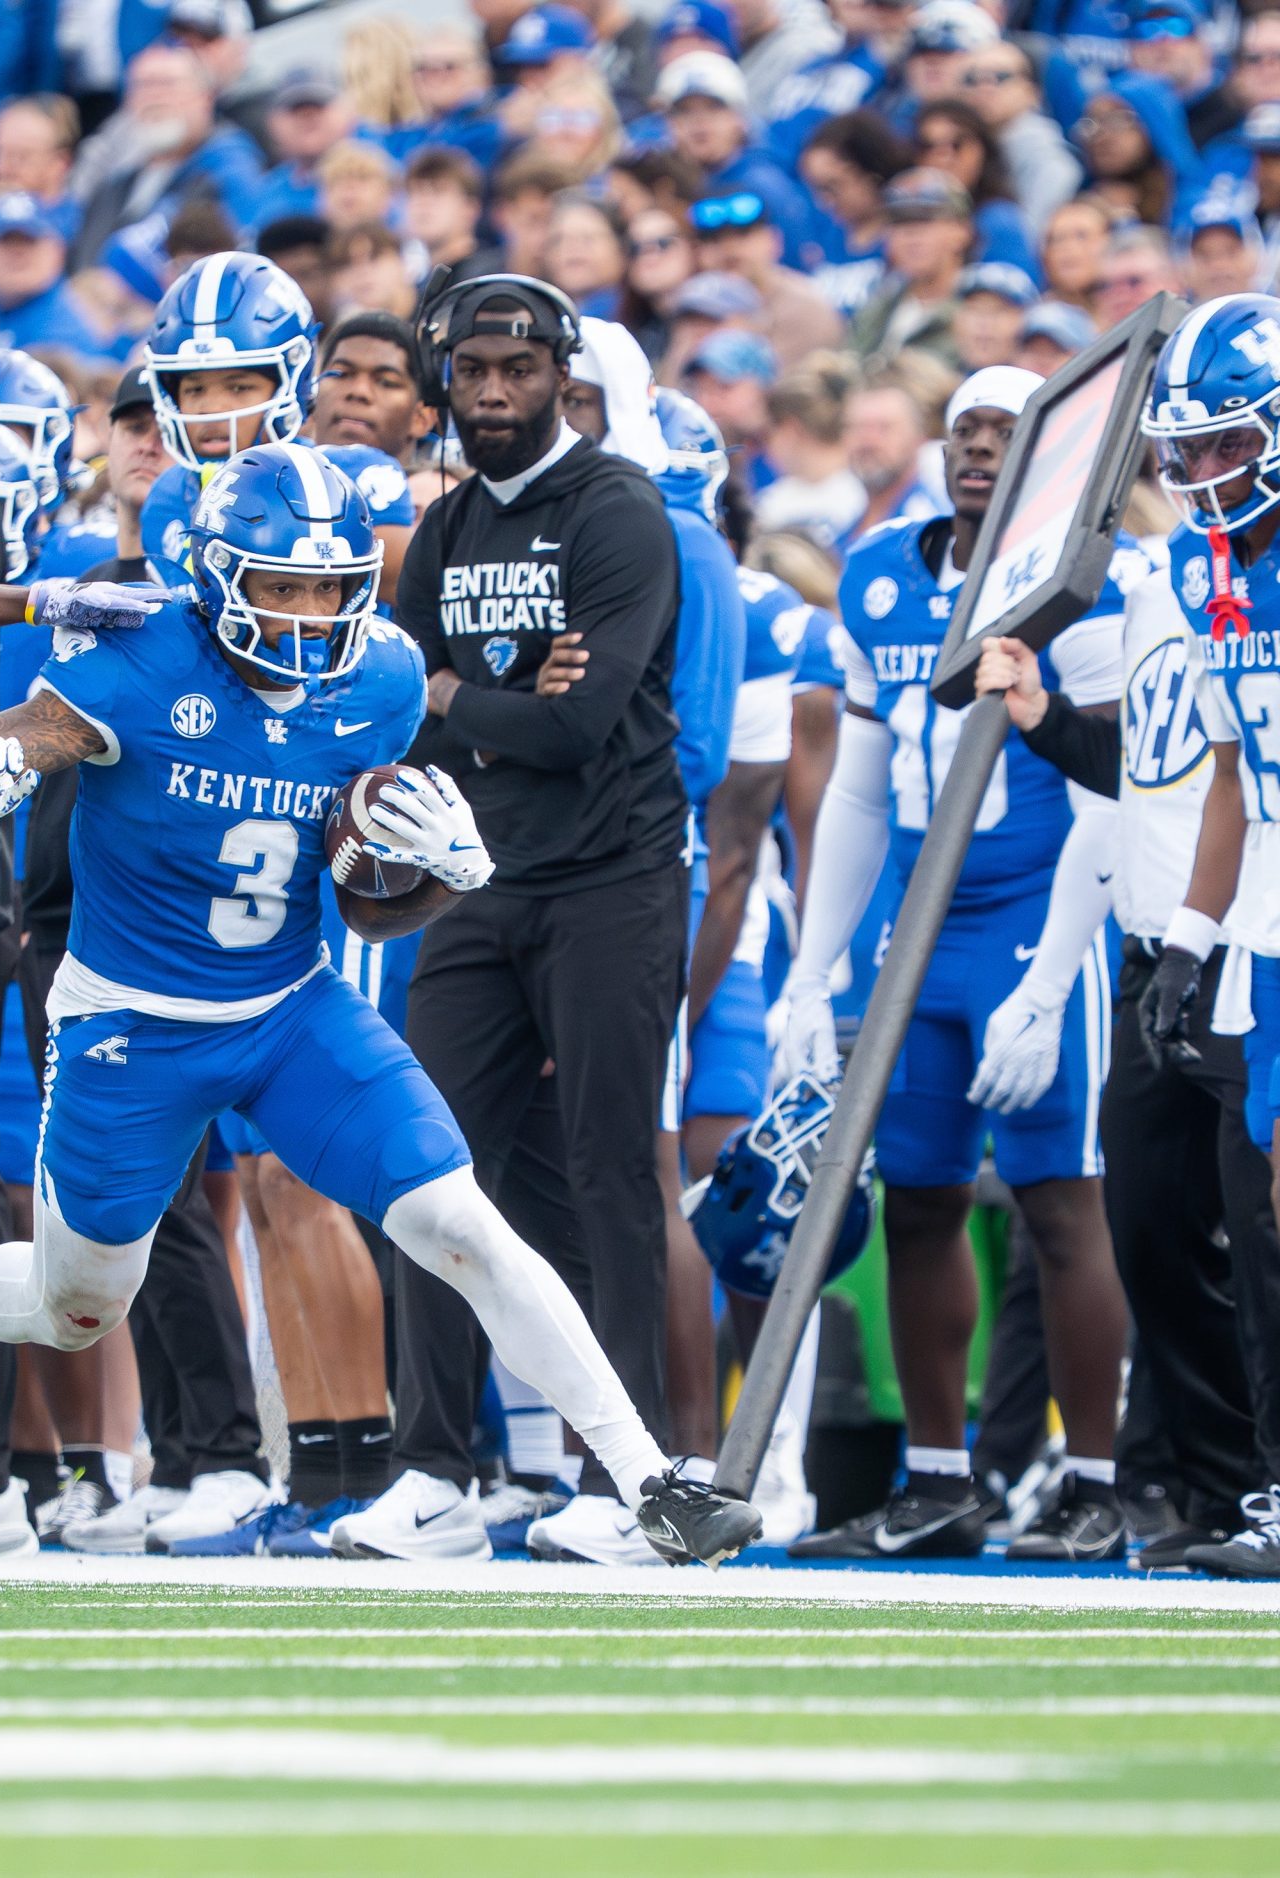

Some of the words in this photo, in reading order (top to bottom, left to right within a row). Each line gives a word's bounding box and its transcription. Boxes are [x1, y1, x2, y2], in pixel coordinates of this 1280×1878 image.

[872, 644, 945, 682] KENT
[174, 696, 213, 737] SEC
[263, 718, 289, 745] UK
[166, 762, 340, 820] KENTUCK
[207, 818, 300, 949] 3
